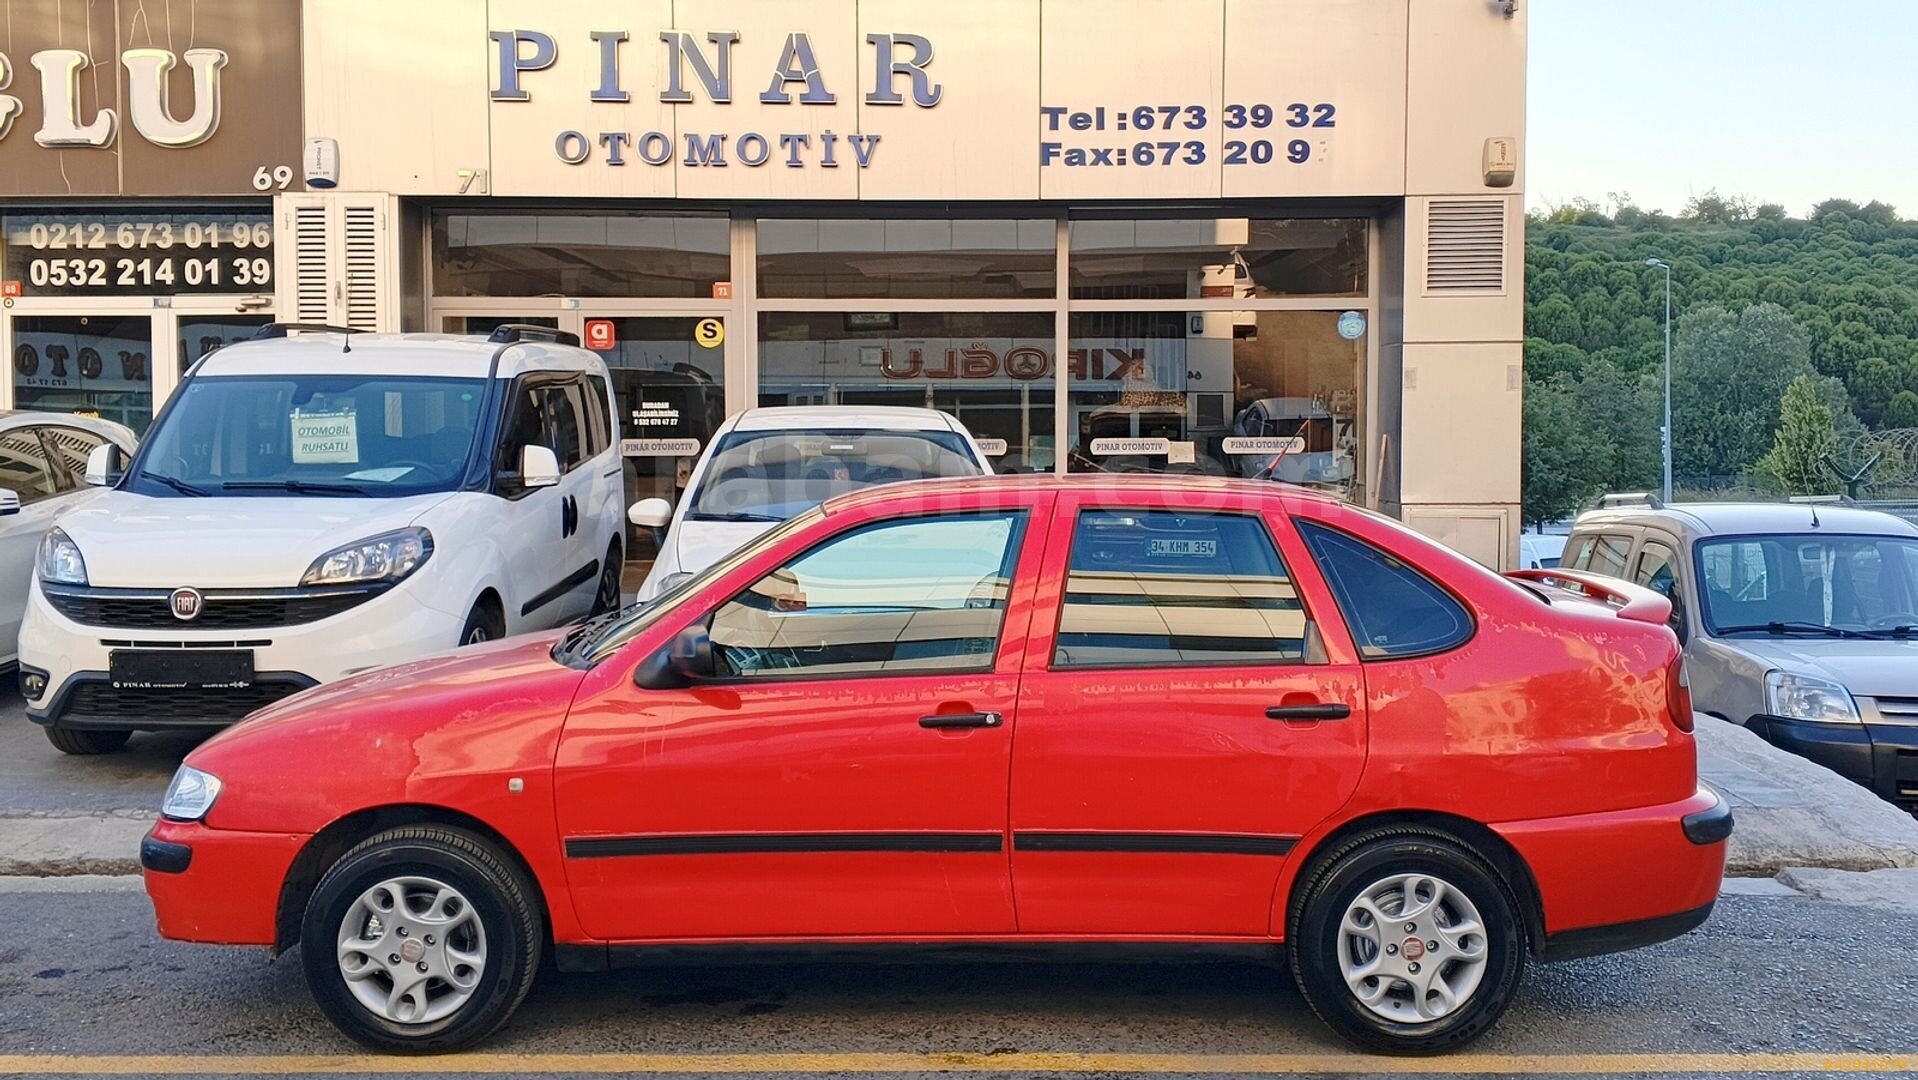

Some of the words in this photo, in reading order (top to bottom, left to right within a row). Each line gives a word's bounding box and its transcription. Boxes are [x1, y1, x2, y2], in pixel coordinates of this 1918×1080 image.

[489, 29, 943, 107] PINAR
[0, 48, 228, 149] LU
[1040, 106, 1105, 131] Tel
[1223, 104, 1273, 128] 39
[1286, 103, 1336, 128] 32
[555, 129, 881, 168] OTOMOTİV
[1223, 140, 1273, 166] 20
[1286, 139, 1326, 164] 9
[252, 165, 293, 191] 69
[456, 168, 488, 194] 71
[30, 222, 106, 249] 0212
[116, 222, 174, 249] 673
[184, 222, 219, 249] 01
[233, 222, 270, 249] 96
[30, 258, 106, 286] 0532
[116, 258, 174, 285] 214
[184, 258, 219, 285] 01
[233, 258, 270, 285] 39
[702, 322, 718, 339] S
[298, 424, 350, 436] OTOMOBİL
[625, 443, 650, 451] PINAR
[1096, 443, 1120, 451] PINAR
[1230, 441, 1254, 449] PINAR
[1152, 541, 1164, 552] 34
[1195, 542, 1213, 553] 354
[177, 597, 196, 611] FIAT
